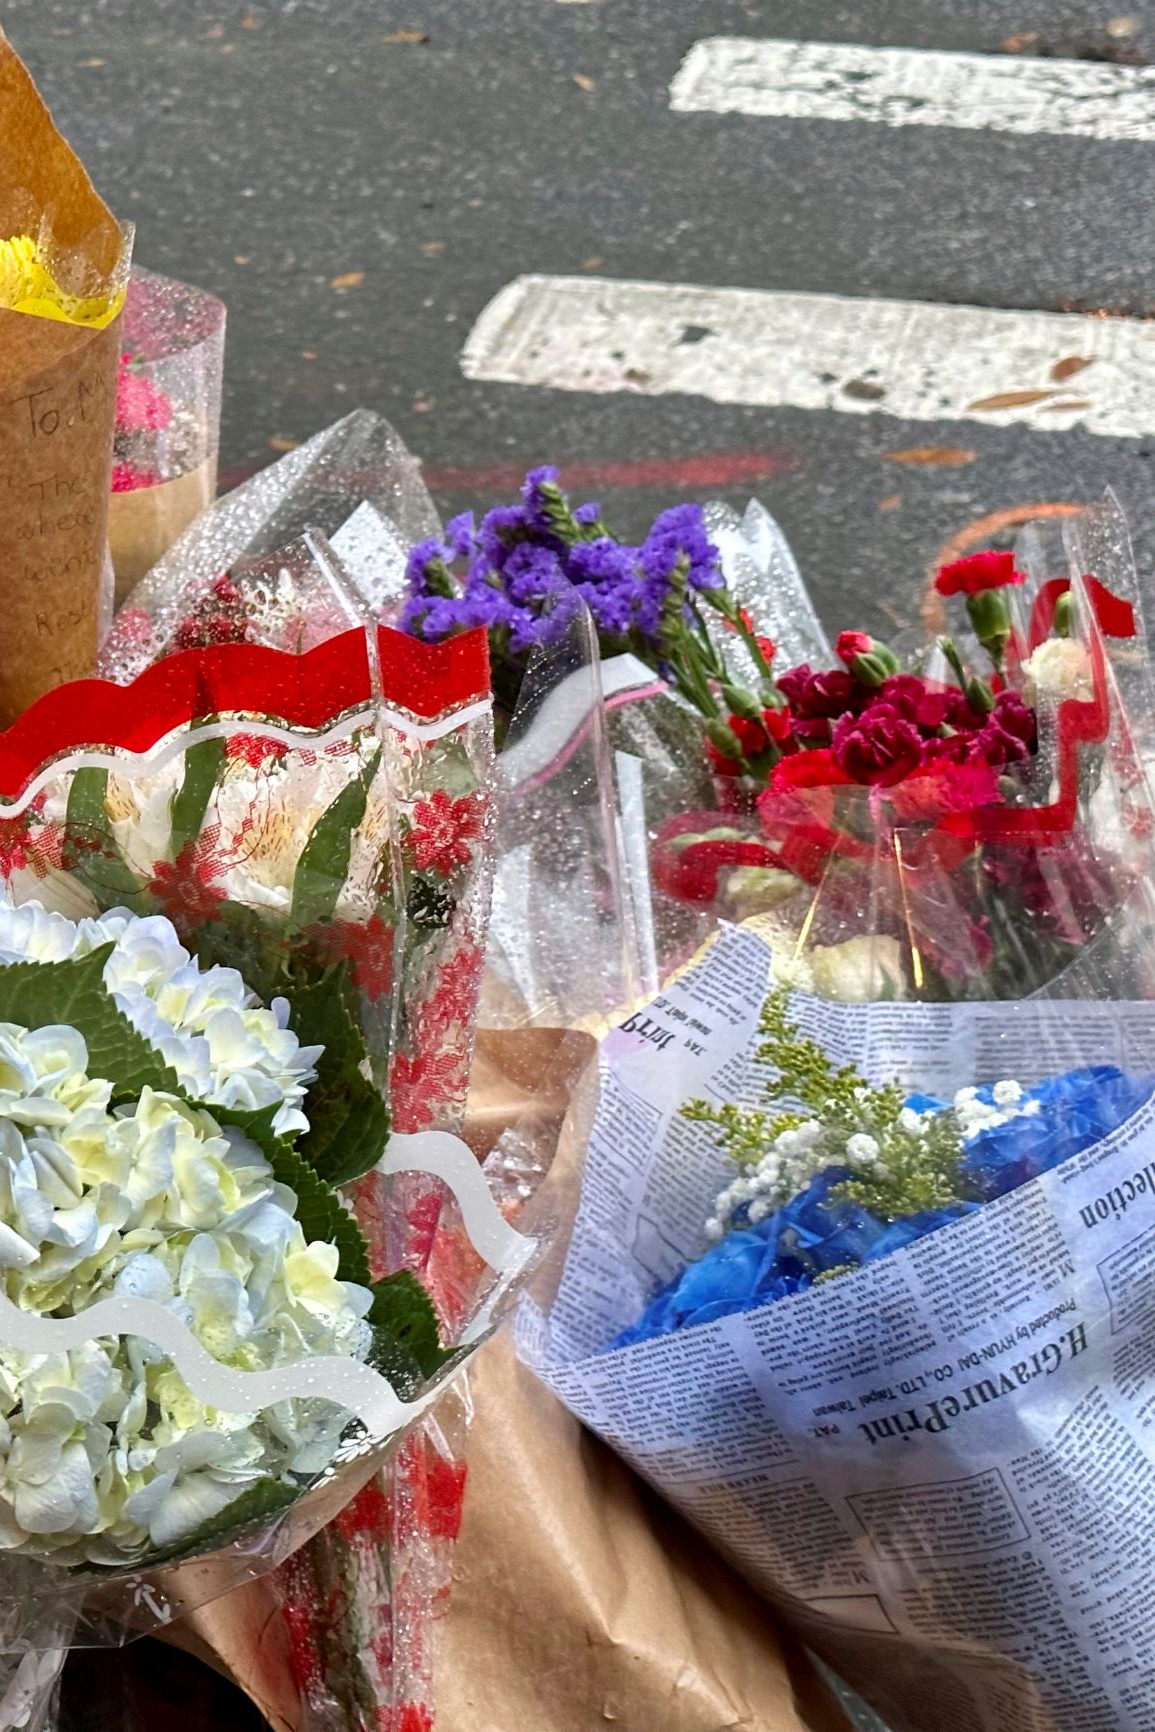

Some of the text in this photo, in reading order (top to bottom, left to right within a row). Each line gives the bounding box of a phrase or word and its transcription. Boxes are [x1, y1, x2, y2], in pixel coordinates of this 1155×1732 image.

[1028, 1297, 1077, 1335] Producted
[1015, 1326, 1030, 1340] by
[956, 1333, 1017, 1371] HYUN-DAI
[857, 1321, 1088, 1445] H.GravurePrint
[895, 1375, 927, 1394] LTD.
[858, 1387, 897, 1407] Taipei
[812, 1399, 855, 1416] Taiwan
[807, 1423, 841, 1438] PAT.
